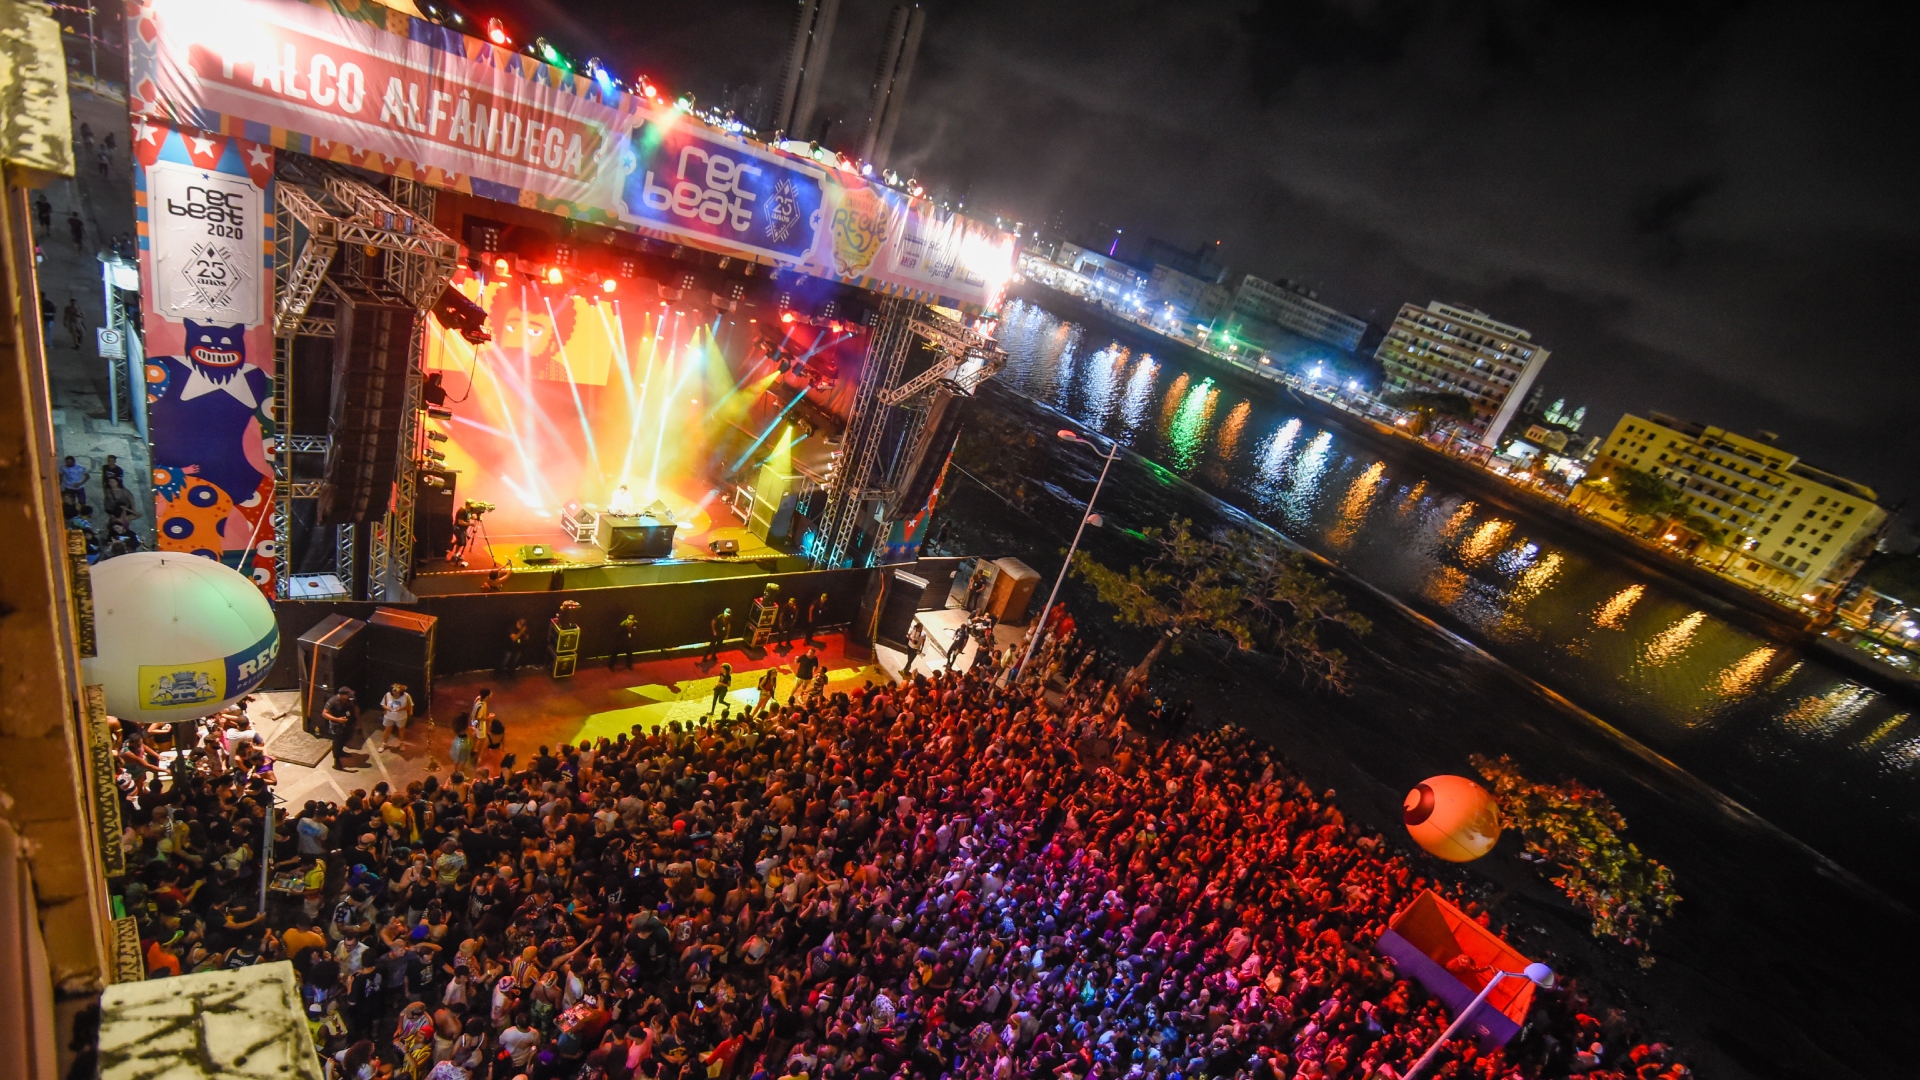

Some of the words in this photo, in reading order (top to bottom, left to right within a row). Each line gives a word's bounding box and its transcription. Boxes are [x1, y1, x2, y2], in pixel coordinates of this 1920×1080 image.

[380, 77, 583, 175] ALFÂNDEGA
[677, 145, 762, 201] rec
[187, 186, 243, 211] rec
[642, 170, 753, 232] beat
[772, 195, 793, 216] 25
[167, 198, 244, 226] beat
[207, 223, 243, 240] 2020
[196, 259, 227, 280] 25
[196, 277, 227, 287] anos
